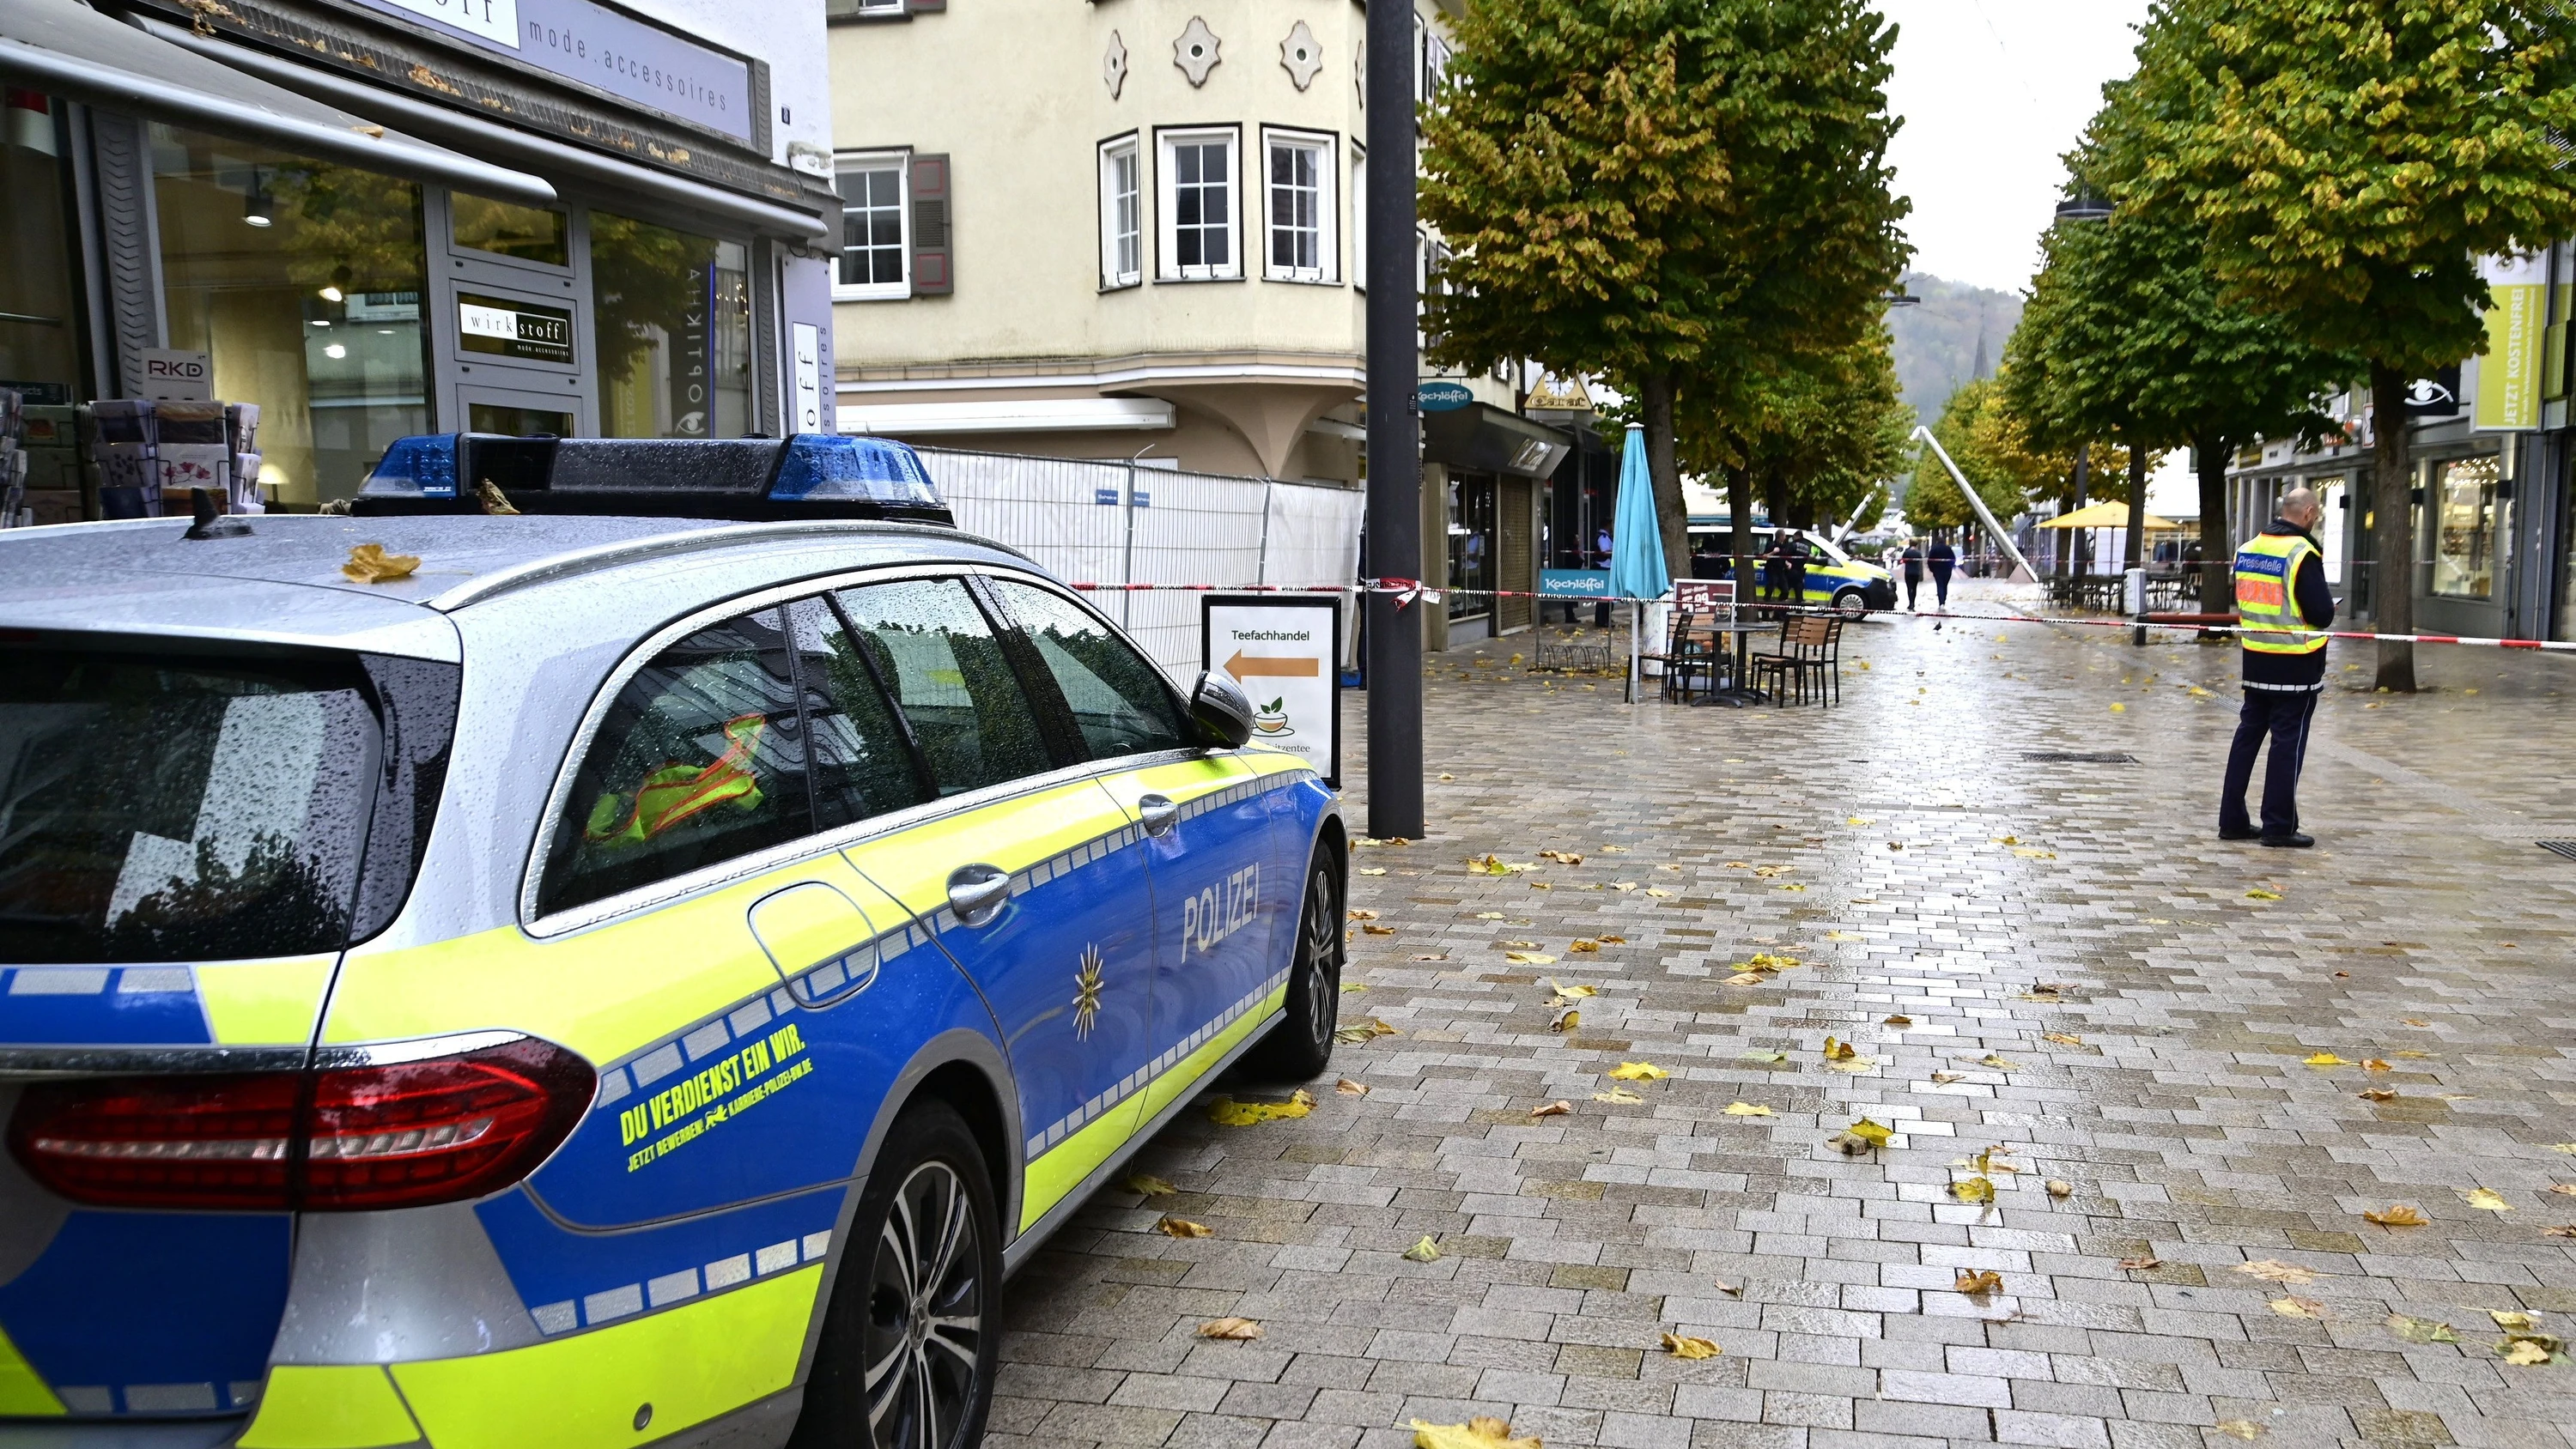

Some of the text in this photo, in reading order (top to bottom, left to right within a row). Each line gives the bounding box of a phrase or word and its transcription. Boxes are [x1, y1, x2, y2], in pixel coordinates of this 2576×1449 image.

[529, 20, 727, 112] mode.accessoires
[149, 360, 204, 378] RKD
[820, 326, 830, 427] ssoires
[2504, 288, 2525, 426] JETZT KOSTENFREI
[798, 351, 816, 427] off
[1531, 396, 1586, 408] Carat
[1545, 578, 1604, 591] Kochlöffel
[1231, 630, 1310, 641] Teefachhandel
[1265, 743, 1311, 753] itzentee
[1181, 862, 1260, 964] POLIZEI
[619, 1022, 806, 1147] DU VERDIENST EIN WIR.
[627, 1143, 656, 1173] JETZT
